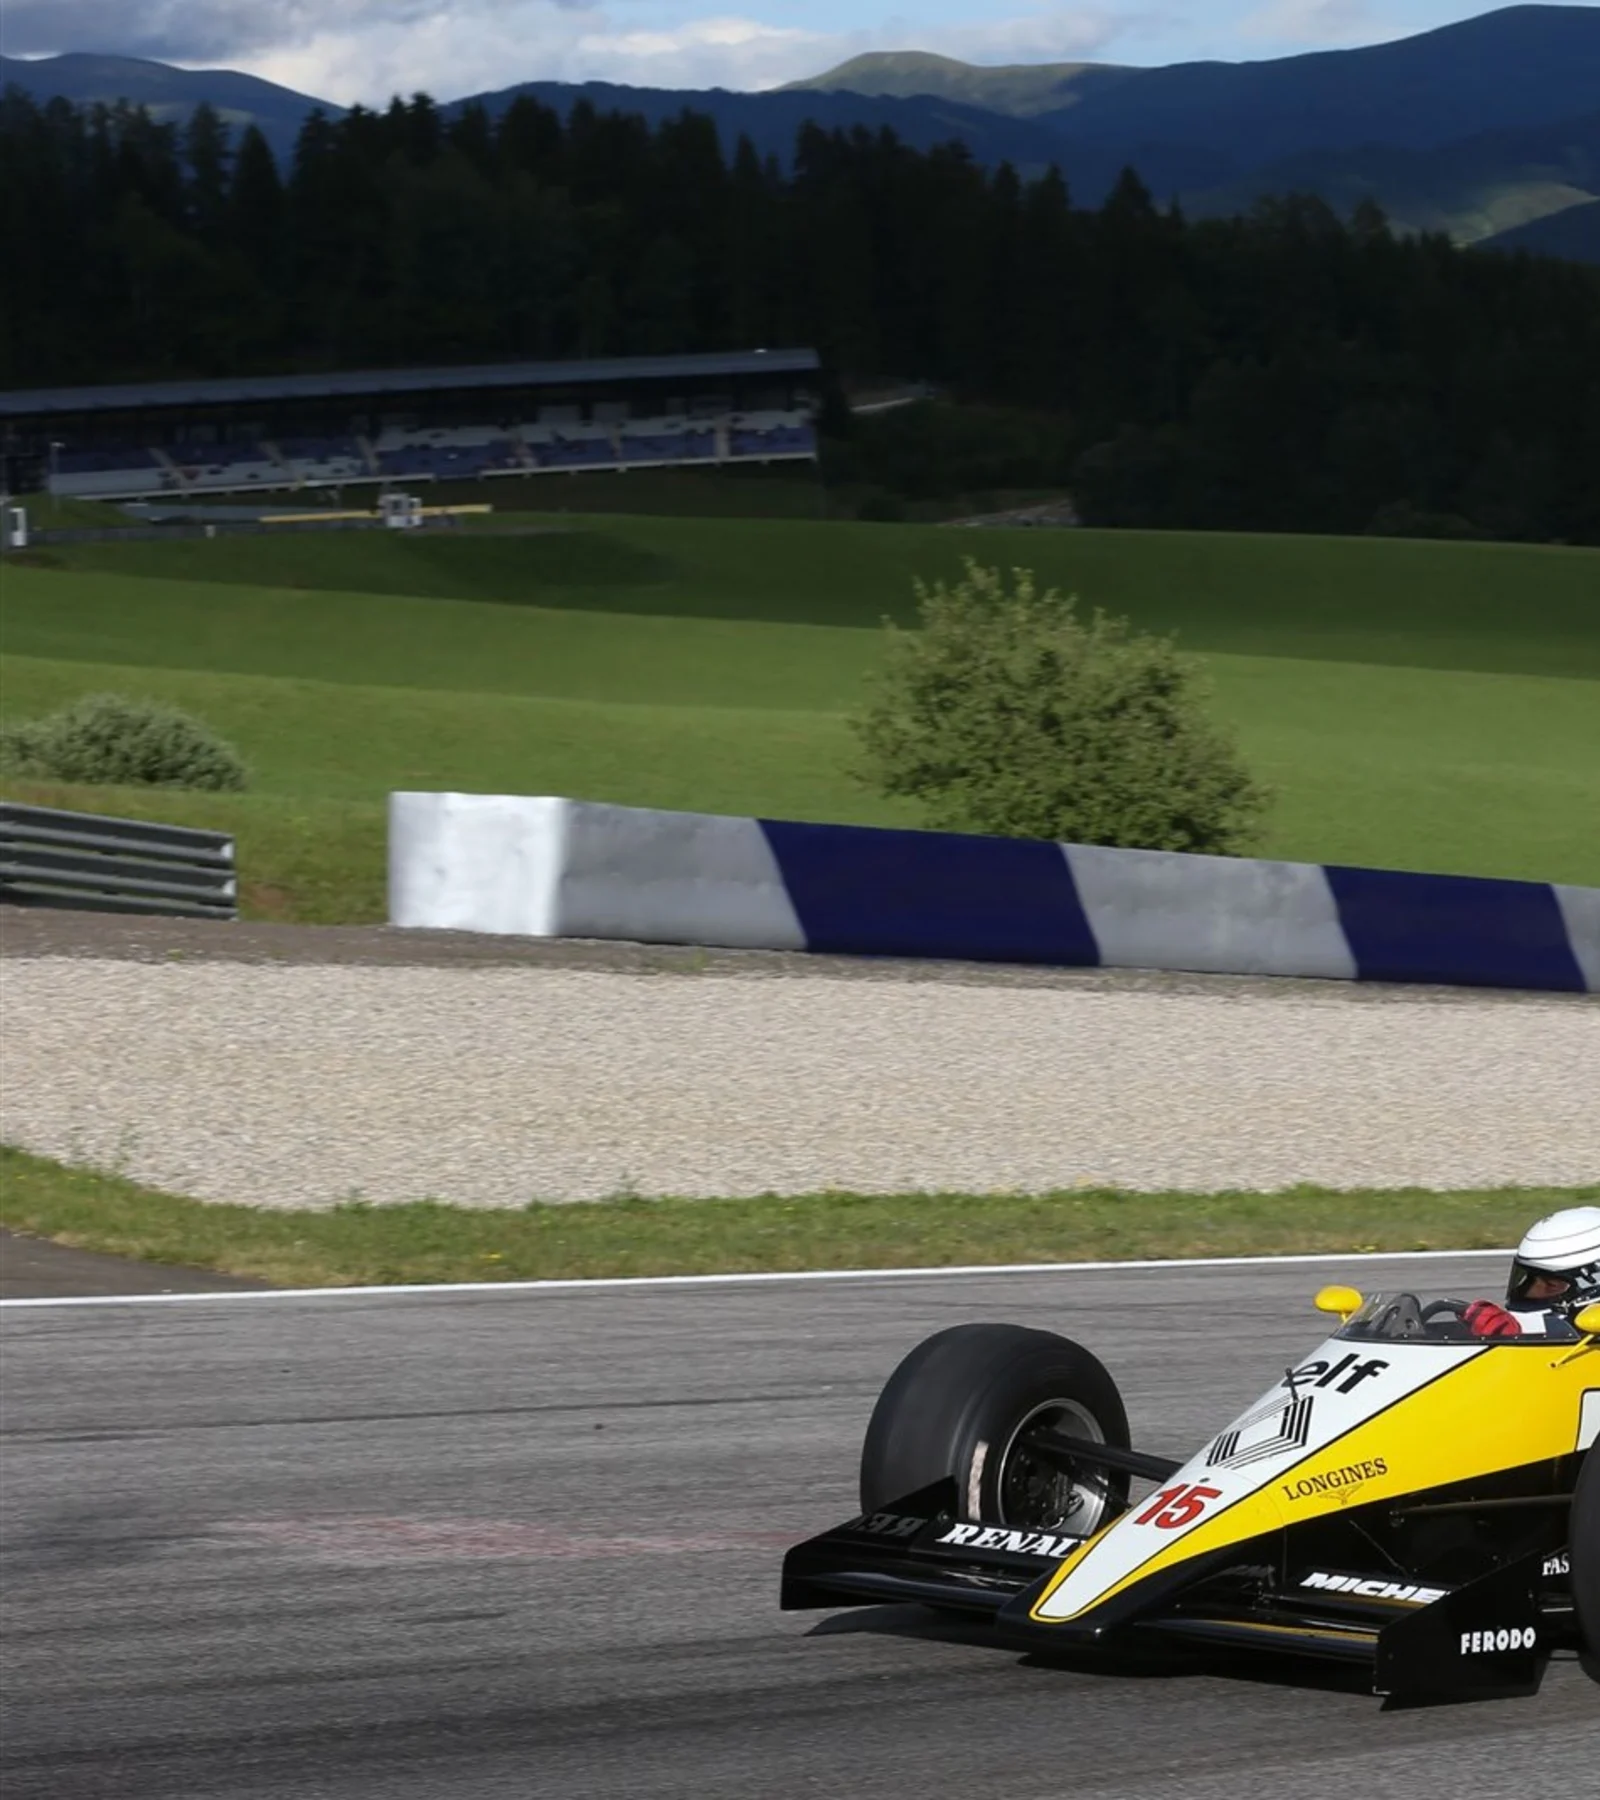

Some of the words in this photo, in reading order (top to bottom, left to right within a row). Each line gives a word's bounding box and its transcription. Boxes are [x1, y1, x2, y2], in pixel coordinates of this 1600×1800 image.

[1281, 1353, 1390, 1394] elf
[1282, 1457, 1388, 1501] LONGINES
[1133, 1483, 1223, 1529] 15
[1300, 1572, 1450, 1604] MICHE
[1461, 1627, 1536, 1655] FERODO
